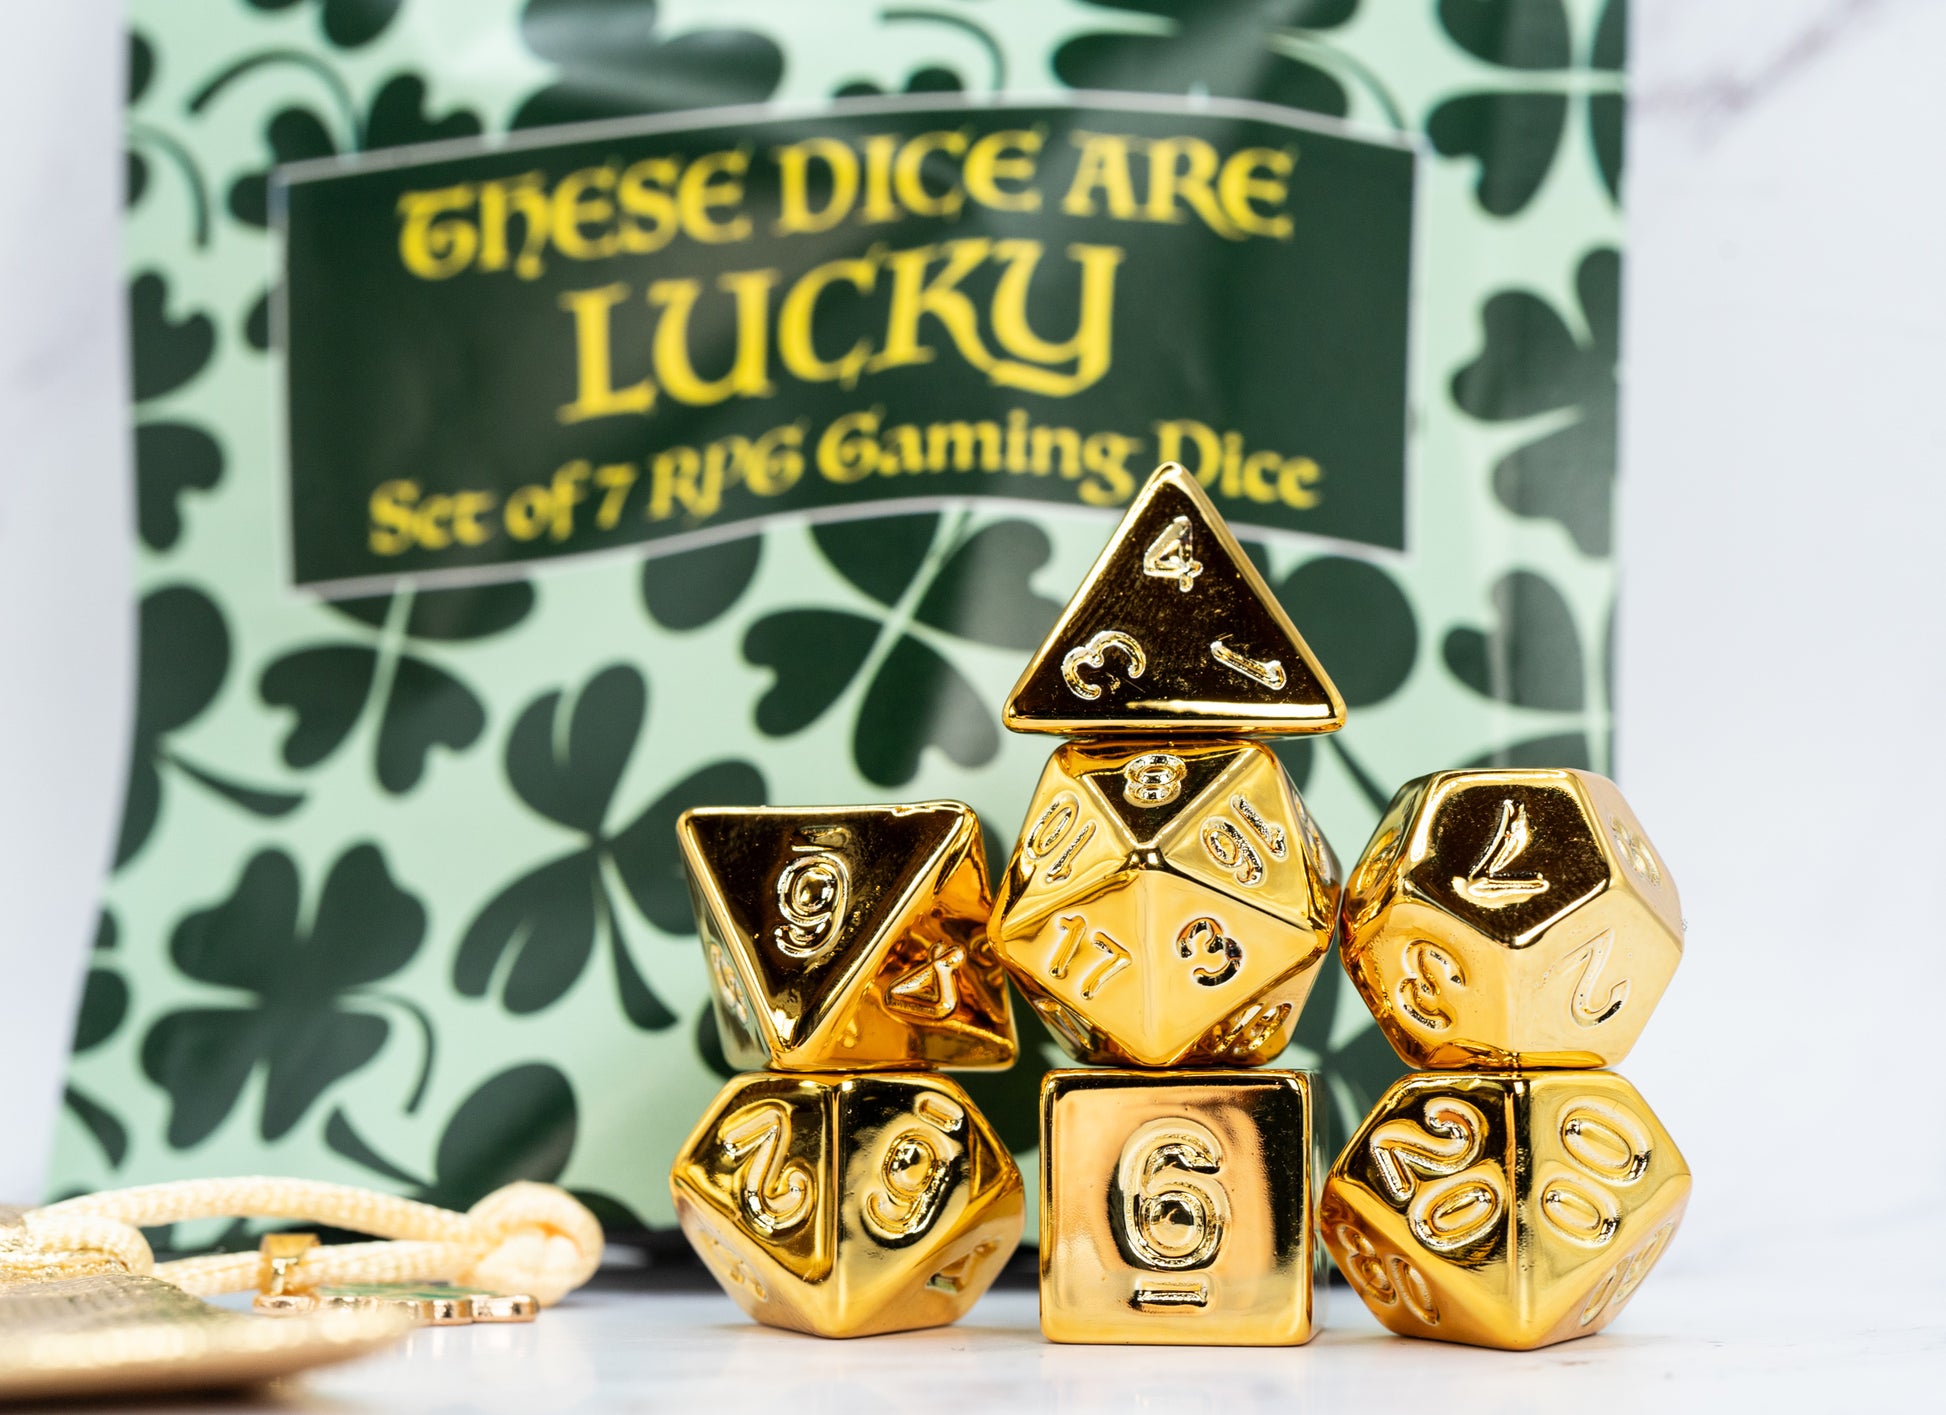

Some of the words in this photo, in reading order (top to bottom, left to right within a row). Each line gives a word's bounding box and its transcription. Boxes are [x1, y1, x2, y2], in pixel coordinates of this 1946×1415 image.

[398, 150, 752, 280] THESE
[777, 130, 1041, 233] DICE
[1065, 130, 1294, 239] ARE
[558, 238, 1123, 424] LUCKY
[368, 479, 489, 555] Set
[503, 460, 590, 540] of
[596, 463, 635, 529] 7
[648, 424, 805, 519] RPG
[817, 408, 1136, 507] Gaming
[1157, 418, 1322, 509] Dice
[1143, 515, 1203, 592] 4
[1062, 630, 1146, 700] 3
[1210, 640, 1287, 690] 1
[1123, 753, 1187, 807] 8
[1049, 915, 1133, 1001] 17
[1176, 917, 1243, 988] 3
[1118, 1116, 1231, 1288] 6
